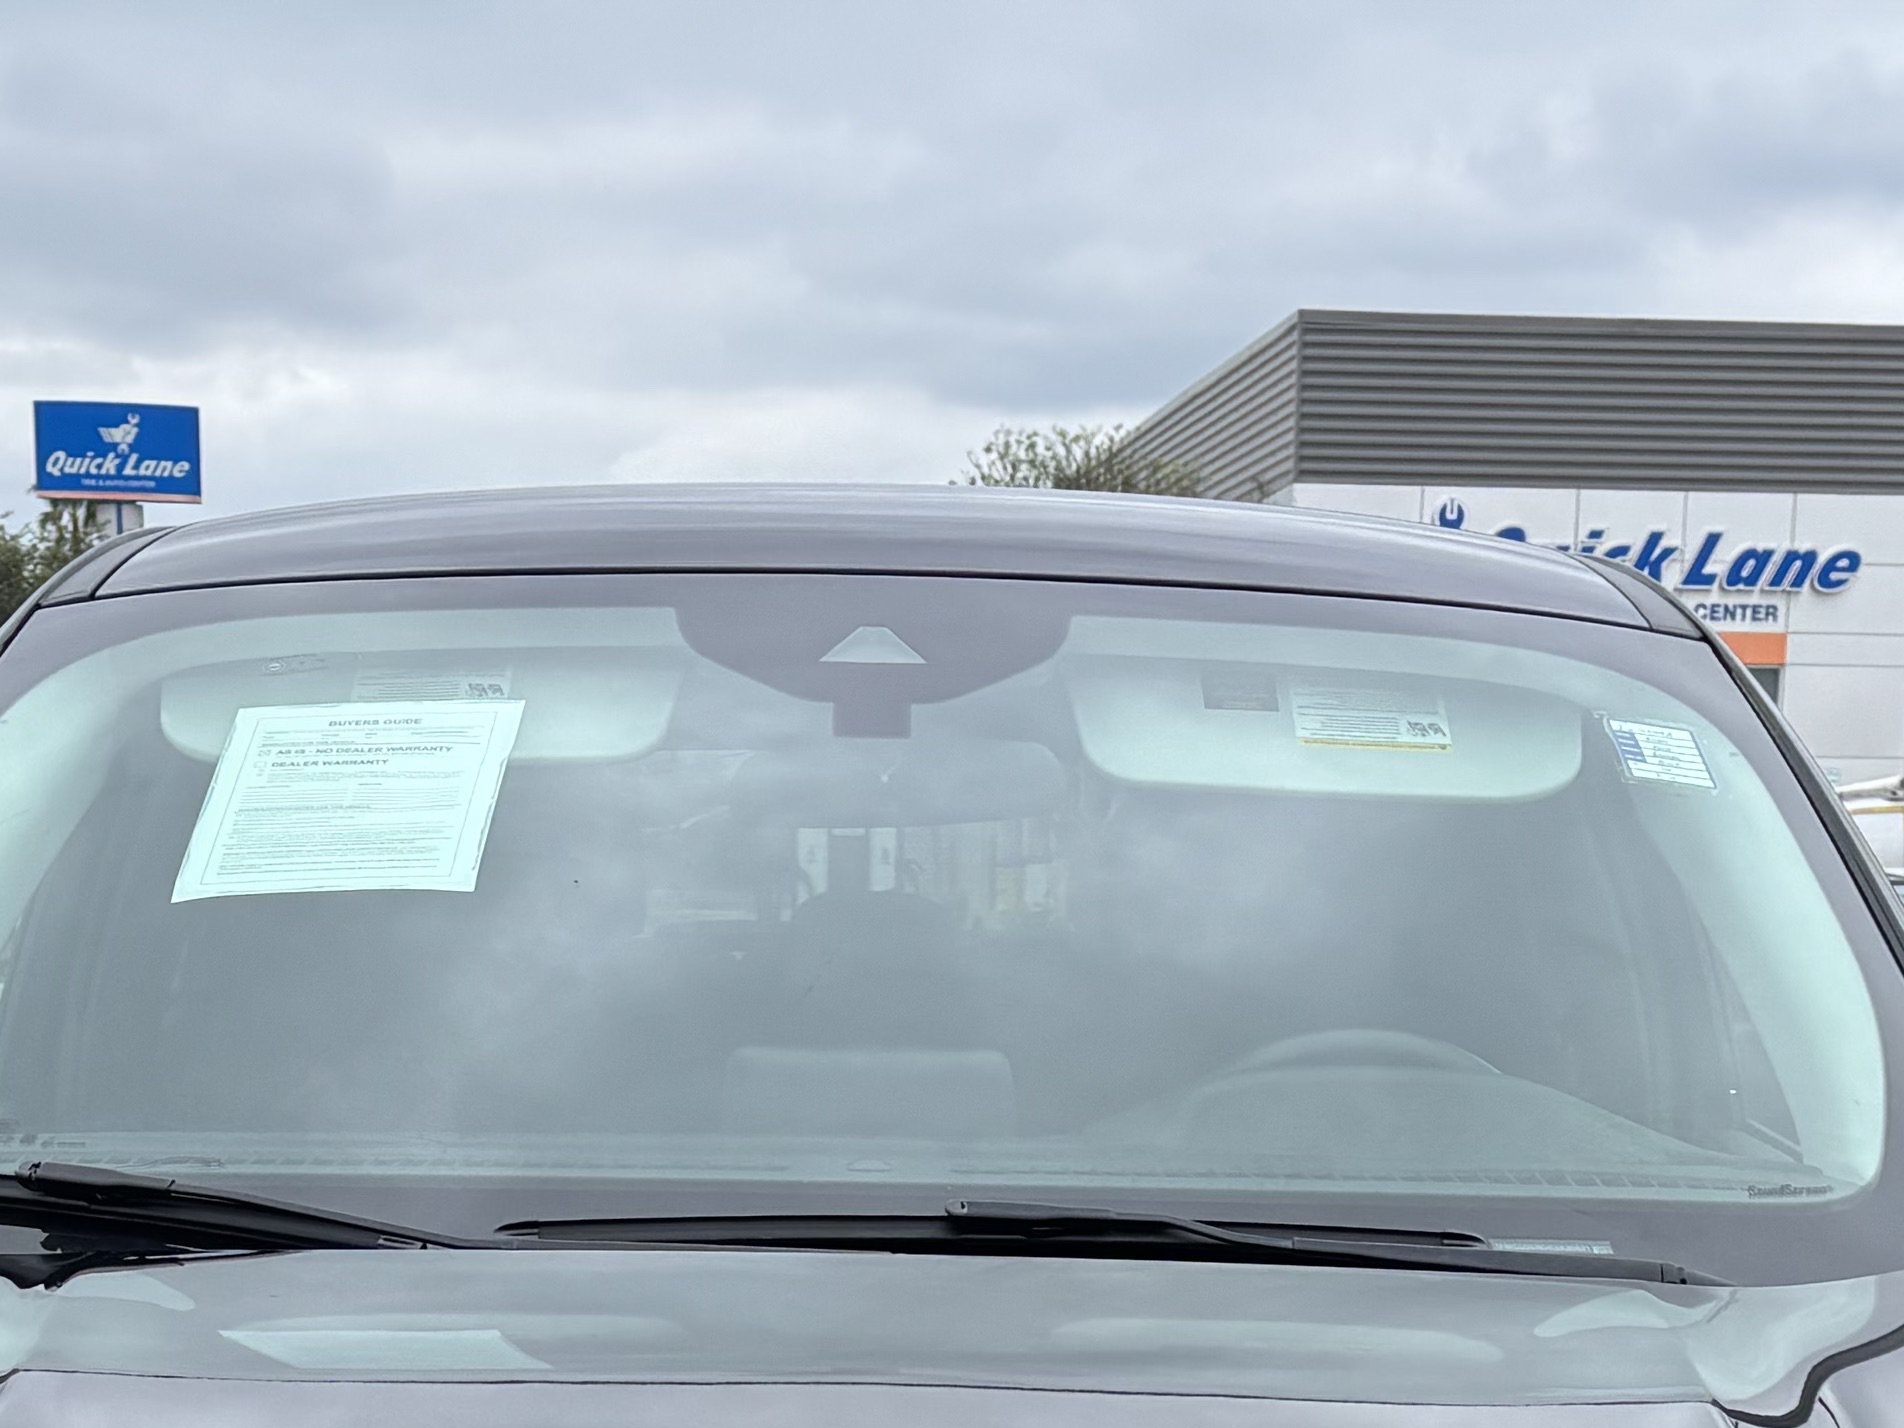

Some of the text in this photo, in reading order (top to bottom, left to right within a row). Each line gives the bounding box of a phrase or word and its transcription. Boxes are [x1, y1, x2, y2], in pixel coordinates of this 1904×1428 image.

[46, 450, 192, 478] Quick Lane
[1683, 532, 1862, 590] Lane
[1694, 603, 1779, 622] CENTER
[328, 718, 424, 727] BUYERS GUIDE
[335, 746, 386, 754] DEALER
[387, 745, 454, 753] WARRANTY
[271, 758, 390, 768] DEALER WARRANTY
